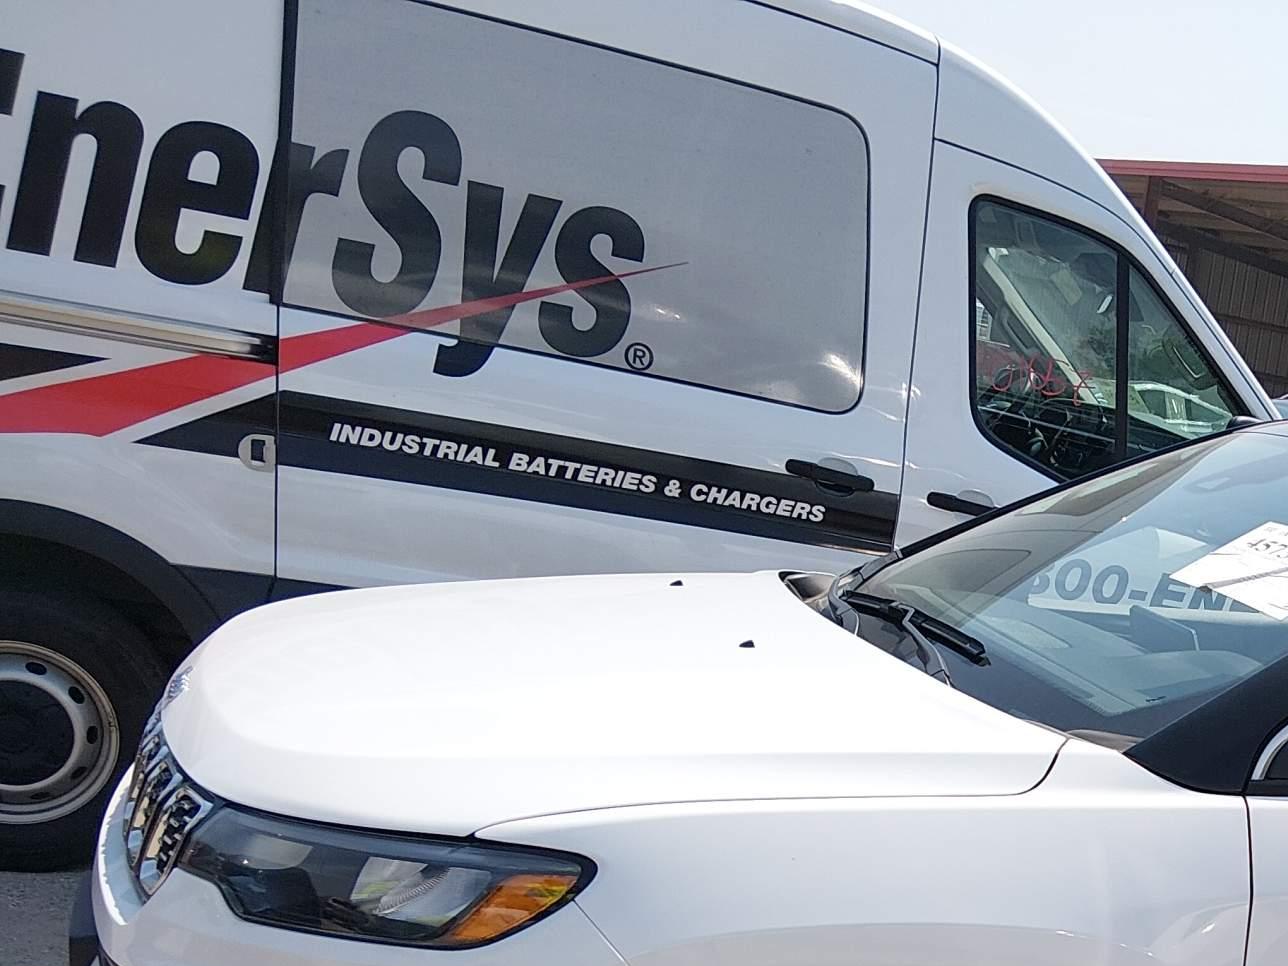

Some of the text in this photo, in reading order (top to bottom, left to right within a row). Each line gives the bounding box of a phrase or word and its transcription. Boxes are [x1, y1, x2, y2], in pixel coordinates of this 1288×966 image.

[329, 422, 825, 523] INDUSTRIAL BATTERIES & CHARGERS
